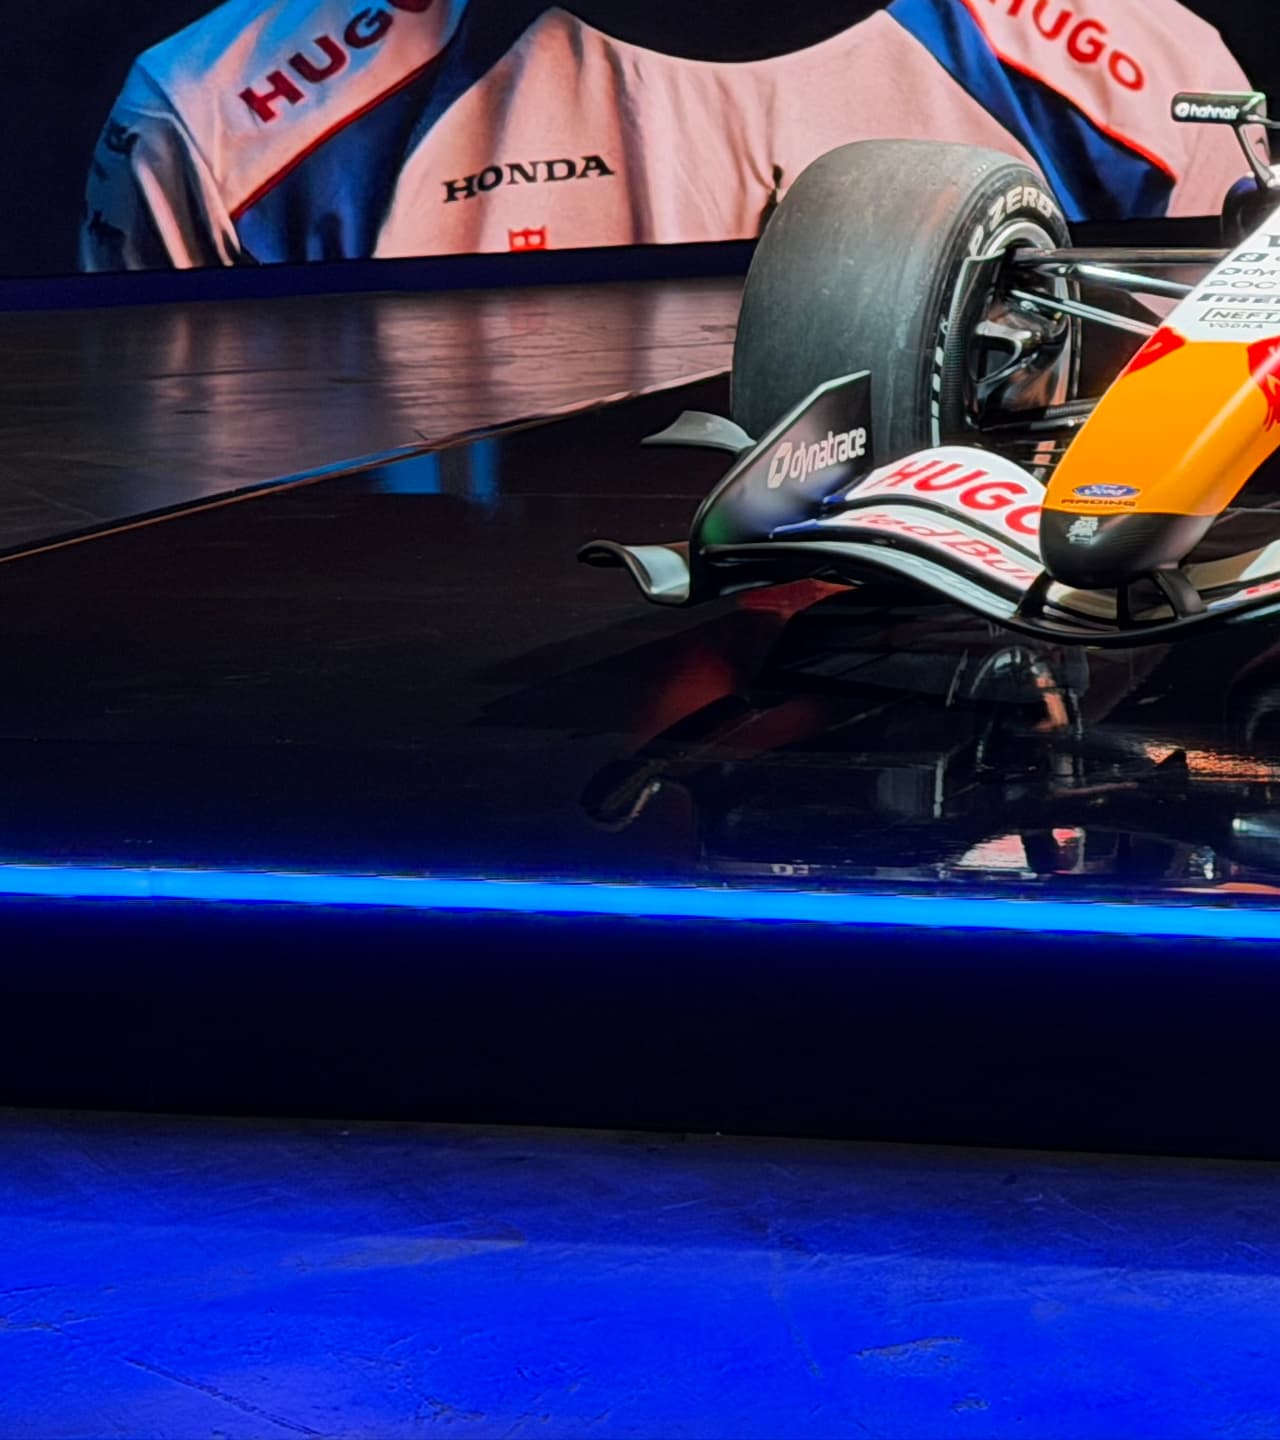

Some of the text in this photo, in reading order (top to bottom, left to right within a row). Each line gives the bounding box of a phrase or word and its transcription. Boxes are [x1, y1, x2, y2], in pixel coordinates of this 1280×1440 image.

[442, 155, 616, 203] HONDA
[1211, 310, 1277, 321] NEFT
[790, 427, 866, 482] dynatrace
